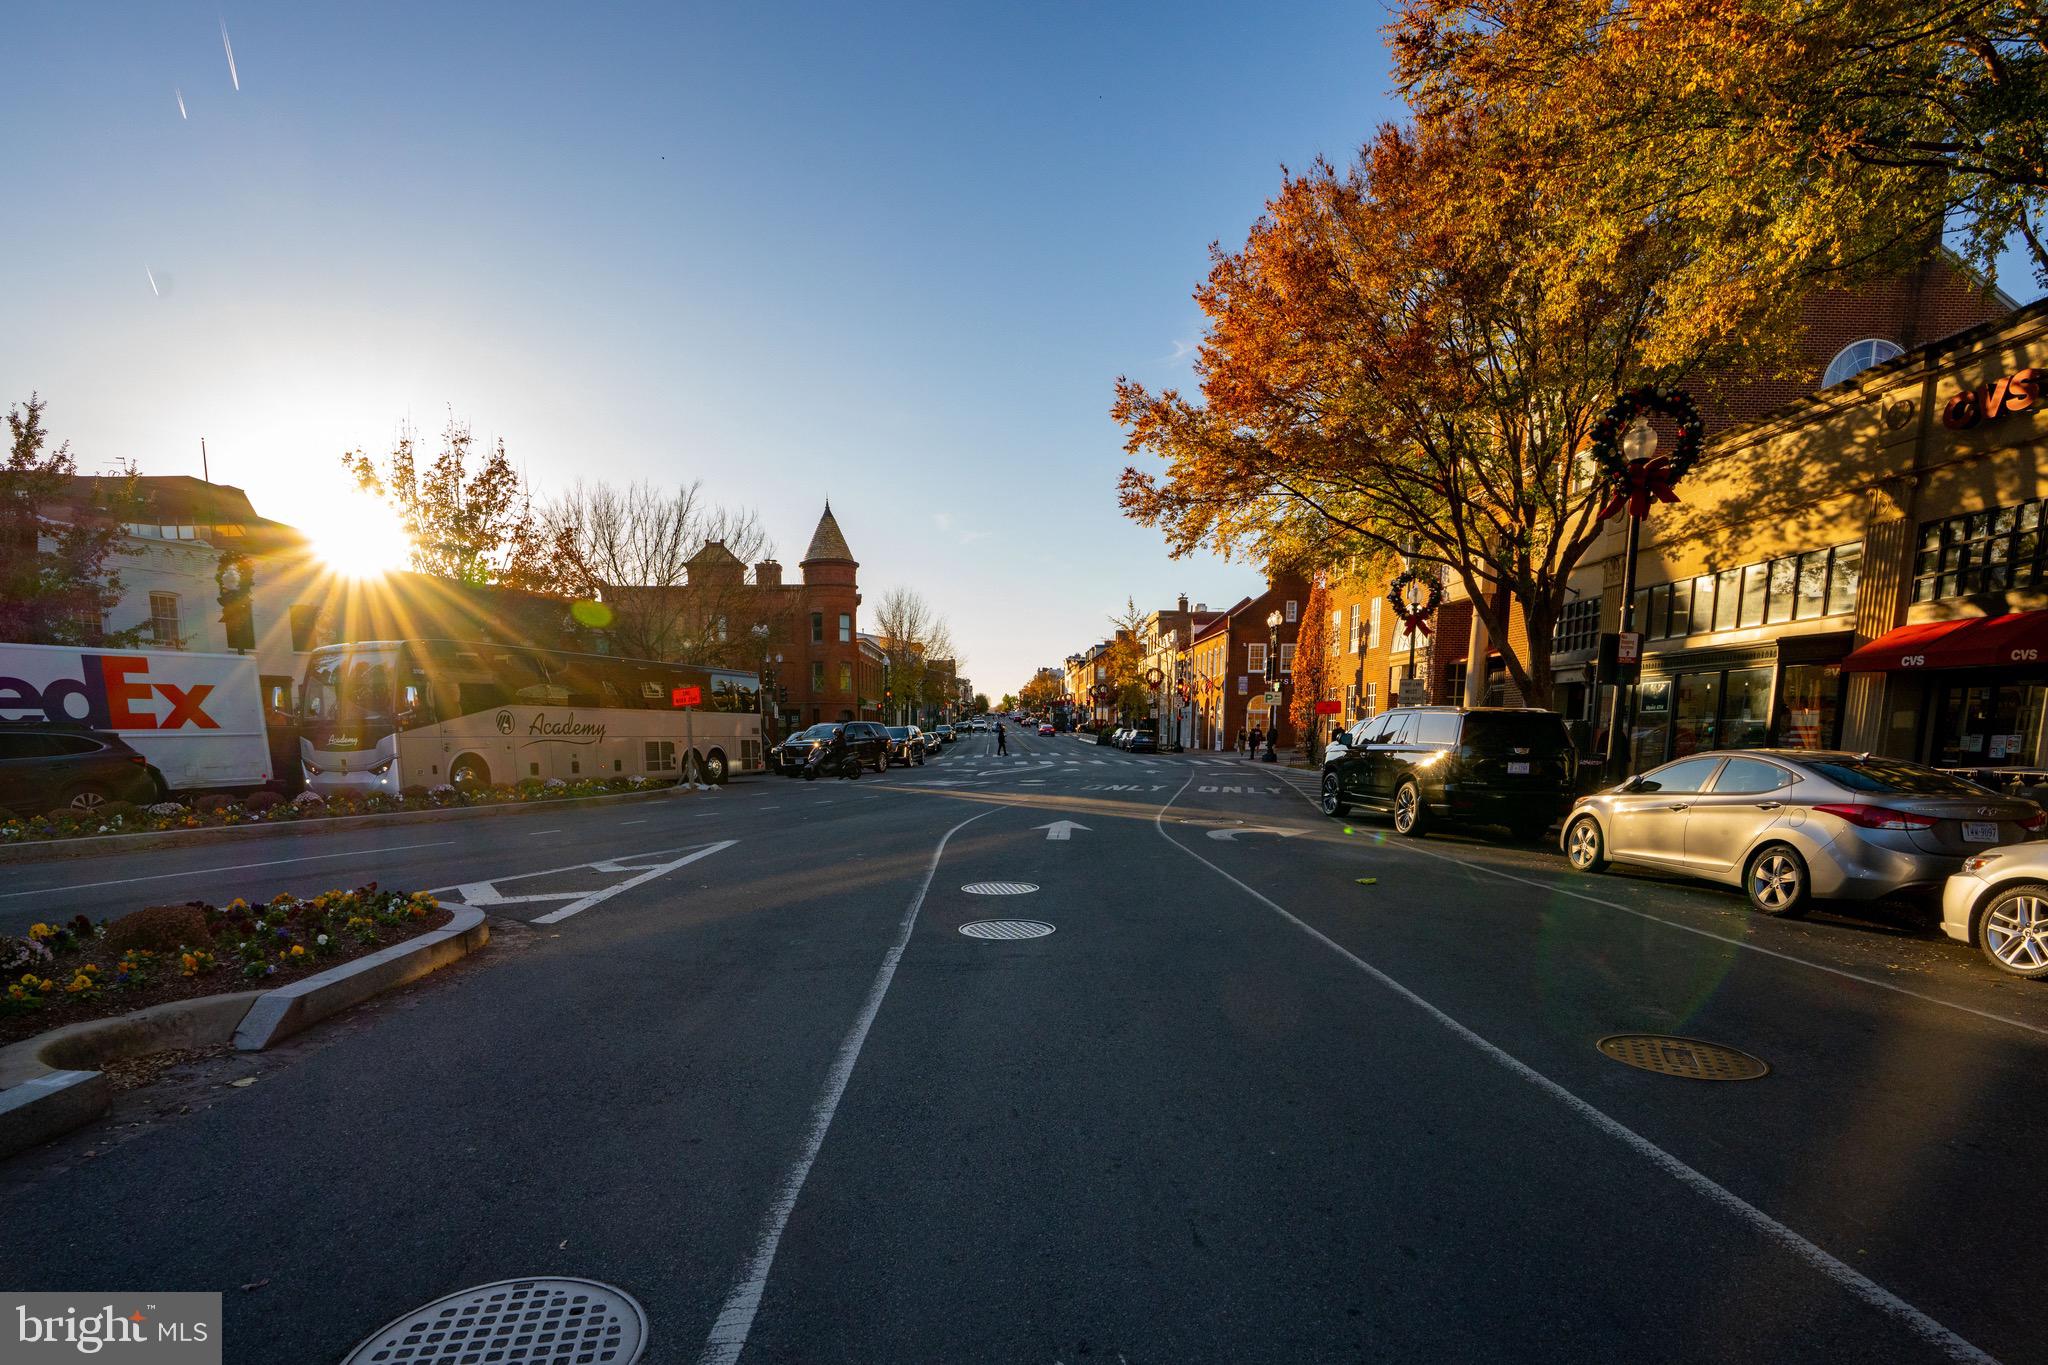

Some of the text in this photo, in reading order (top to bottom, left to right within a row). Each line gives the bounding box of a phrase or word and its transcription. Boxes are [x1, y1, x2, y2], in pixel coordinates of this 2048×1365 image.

[1943, 368, 2040, 430] CVS
[2010, 649, 2038, 660] CVS
[1901, 655, 1925, 666] CVS
[0, 654, 221, 729] edEx
[529, 712, 606, 744] Academy
[328, 734, 358, 746] Academy
[1080, 784, 1168, 792] ONLY
[1198, 785, 1282, 794] ONLY
